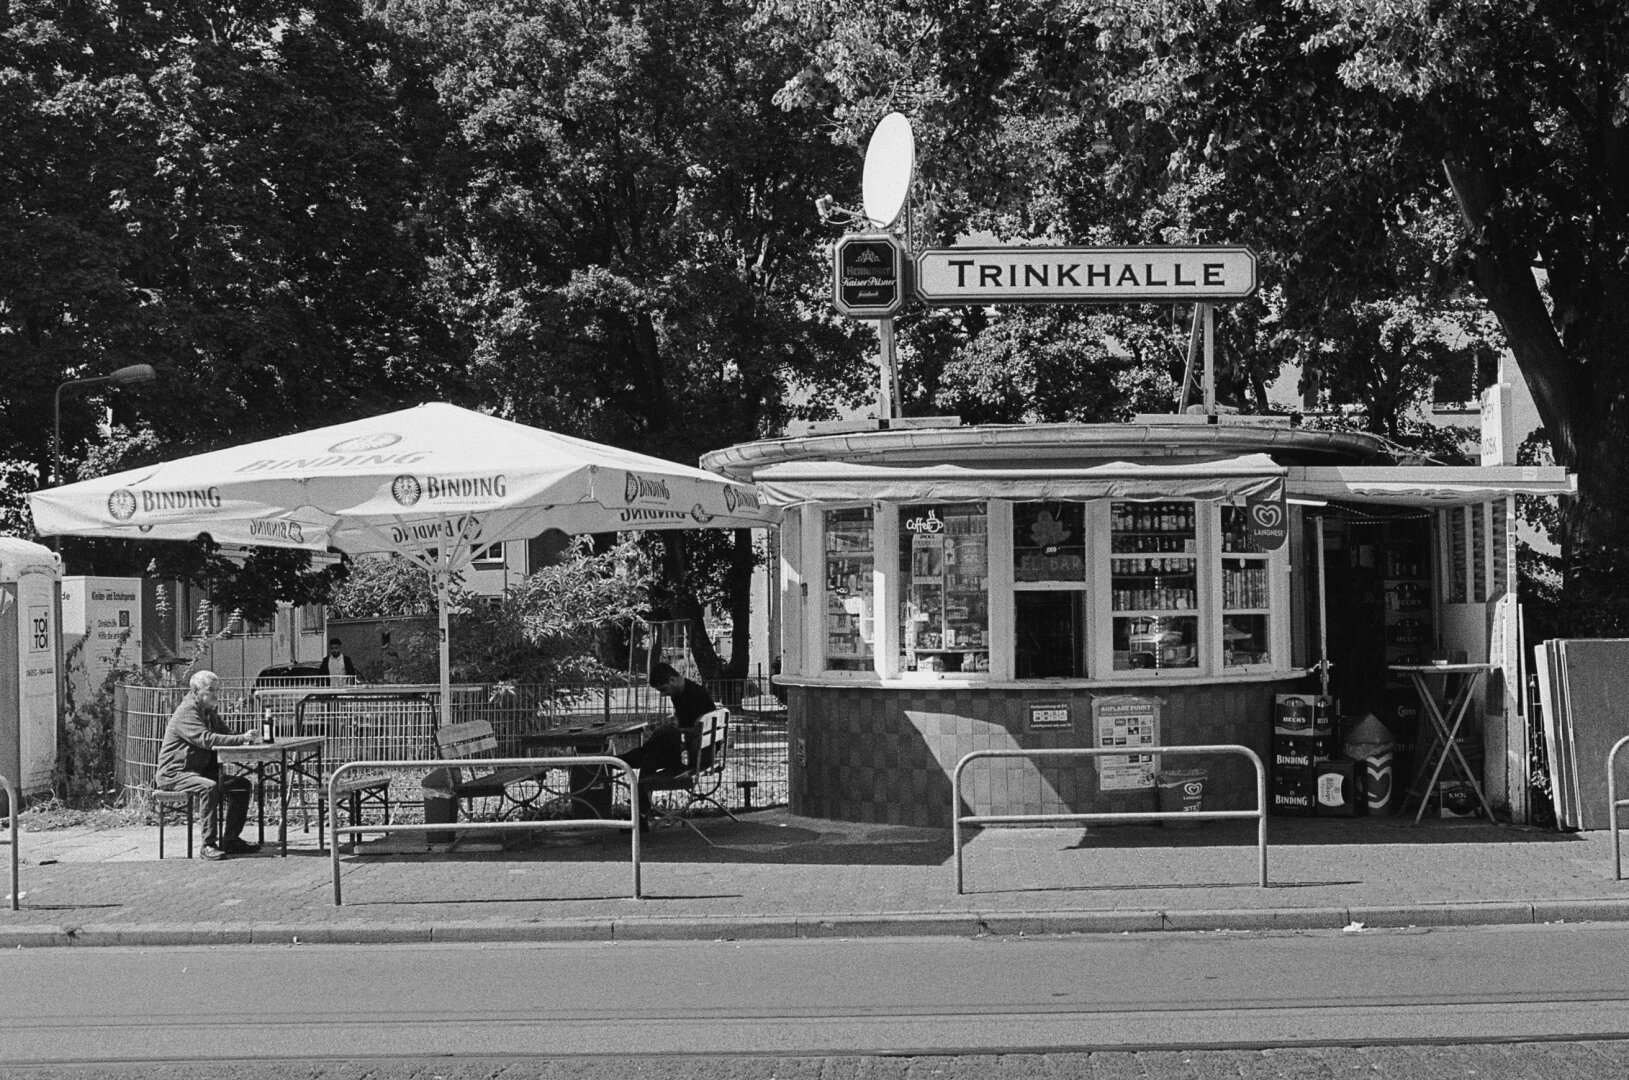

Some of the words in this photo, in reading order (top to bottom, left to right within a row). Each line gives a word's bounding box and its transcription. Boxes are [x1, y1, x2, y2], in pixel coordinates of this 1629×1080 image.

[840, 276, 868, 287] Kaiser
[867, 276, 897, 287] Pilsner
[948, 259, 1226, 288] TRINKHALLE
[235, 450, 433, 473] BINDING
[427, 474, 507, 500] BINDING
[638, 475, 670, 500] BINDING
[142, 485, 221, 513] BINDING
[906, 516, 934, 533] Coffee
[1276, 754, 1309, 766] BINDING
[1276, 794, 1308, 806] BINDING
